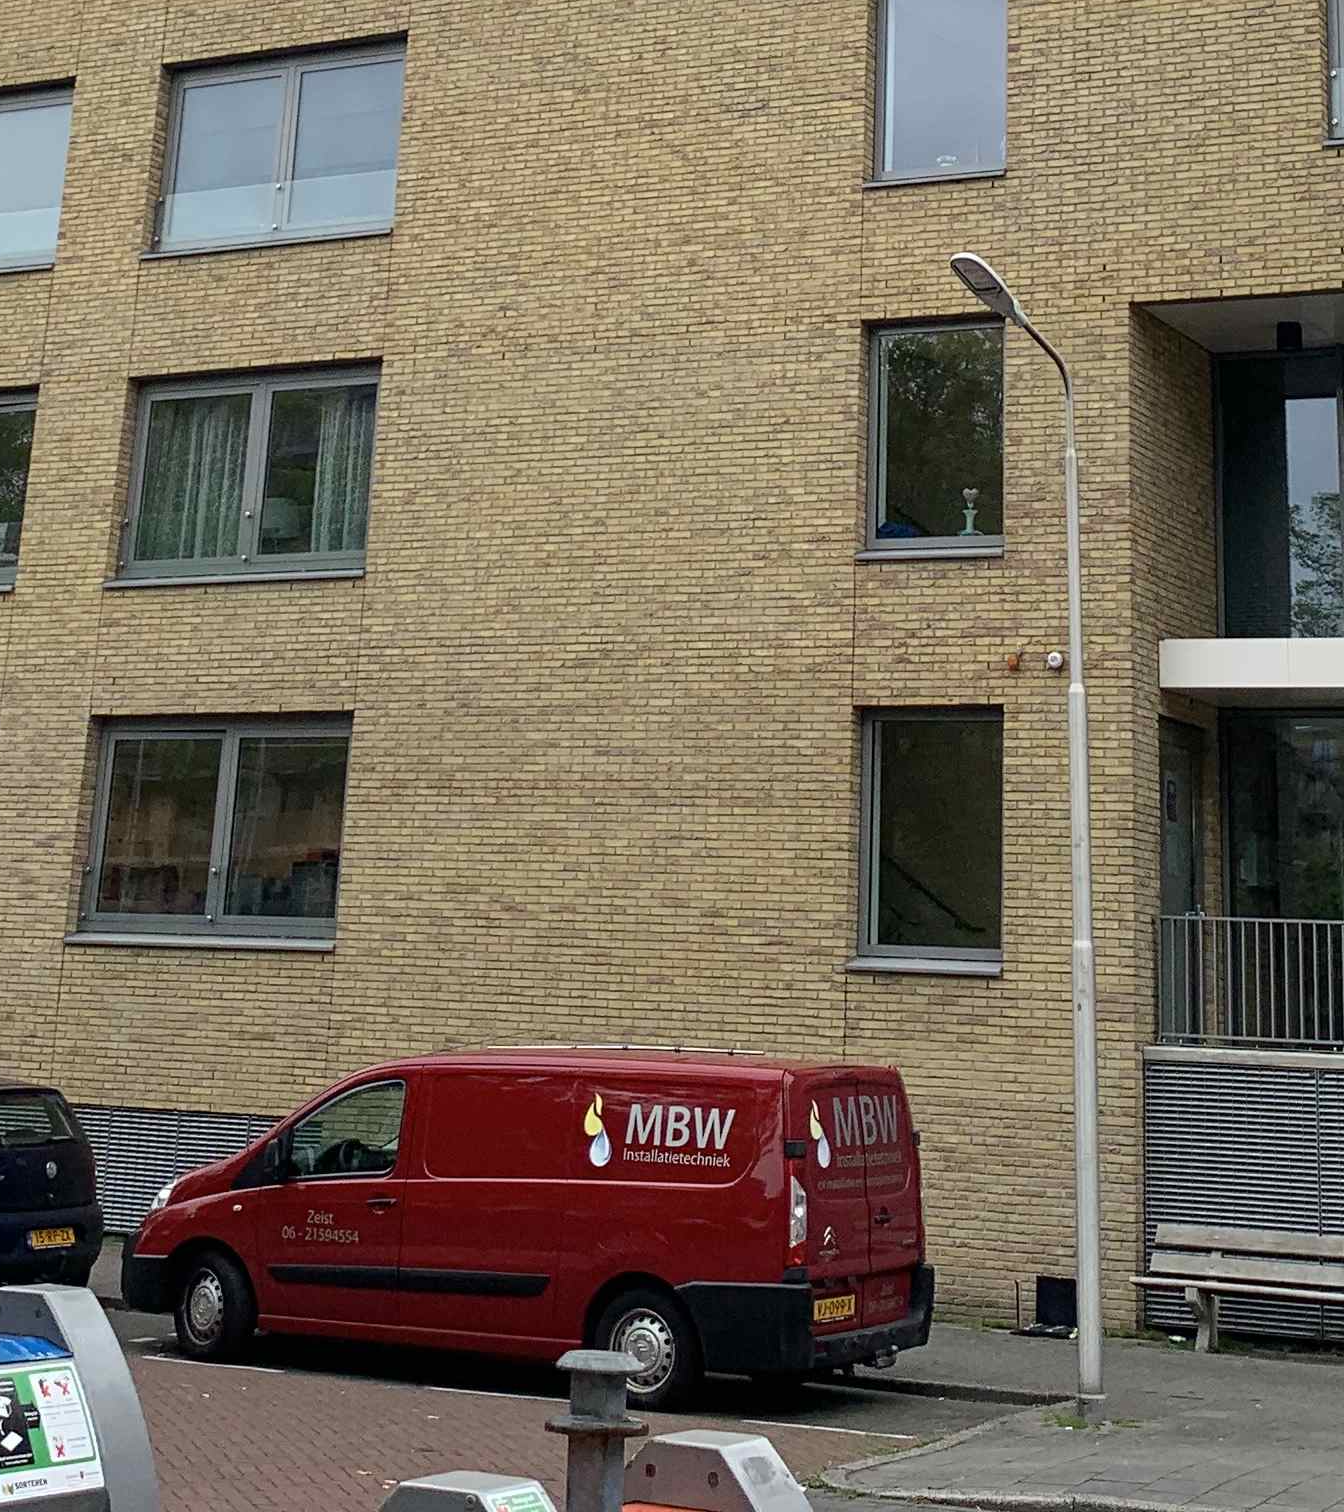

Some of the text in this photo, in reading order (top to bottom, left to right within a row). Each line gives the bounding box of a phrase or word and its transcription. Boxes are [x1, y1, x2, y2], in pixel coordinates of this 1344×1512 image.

[625, 1103, 736, 1150] MBW
[833, 1095, 897, 1147] MBW
[623, 1147, 731, 1168] Installatietechniek
[306, 1209, 335, 1225] Zeist
[281, 1225, 296, 1239] 06
